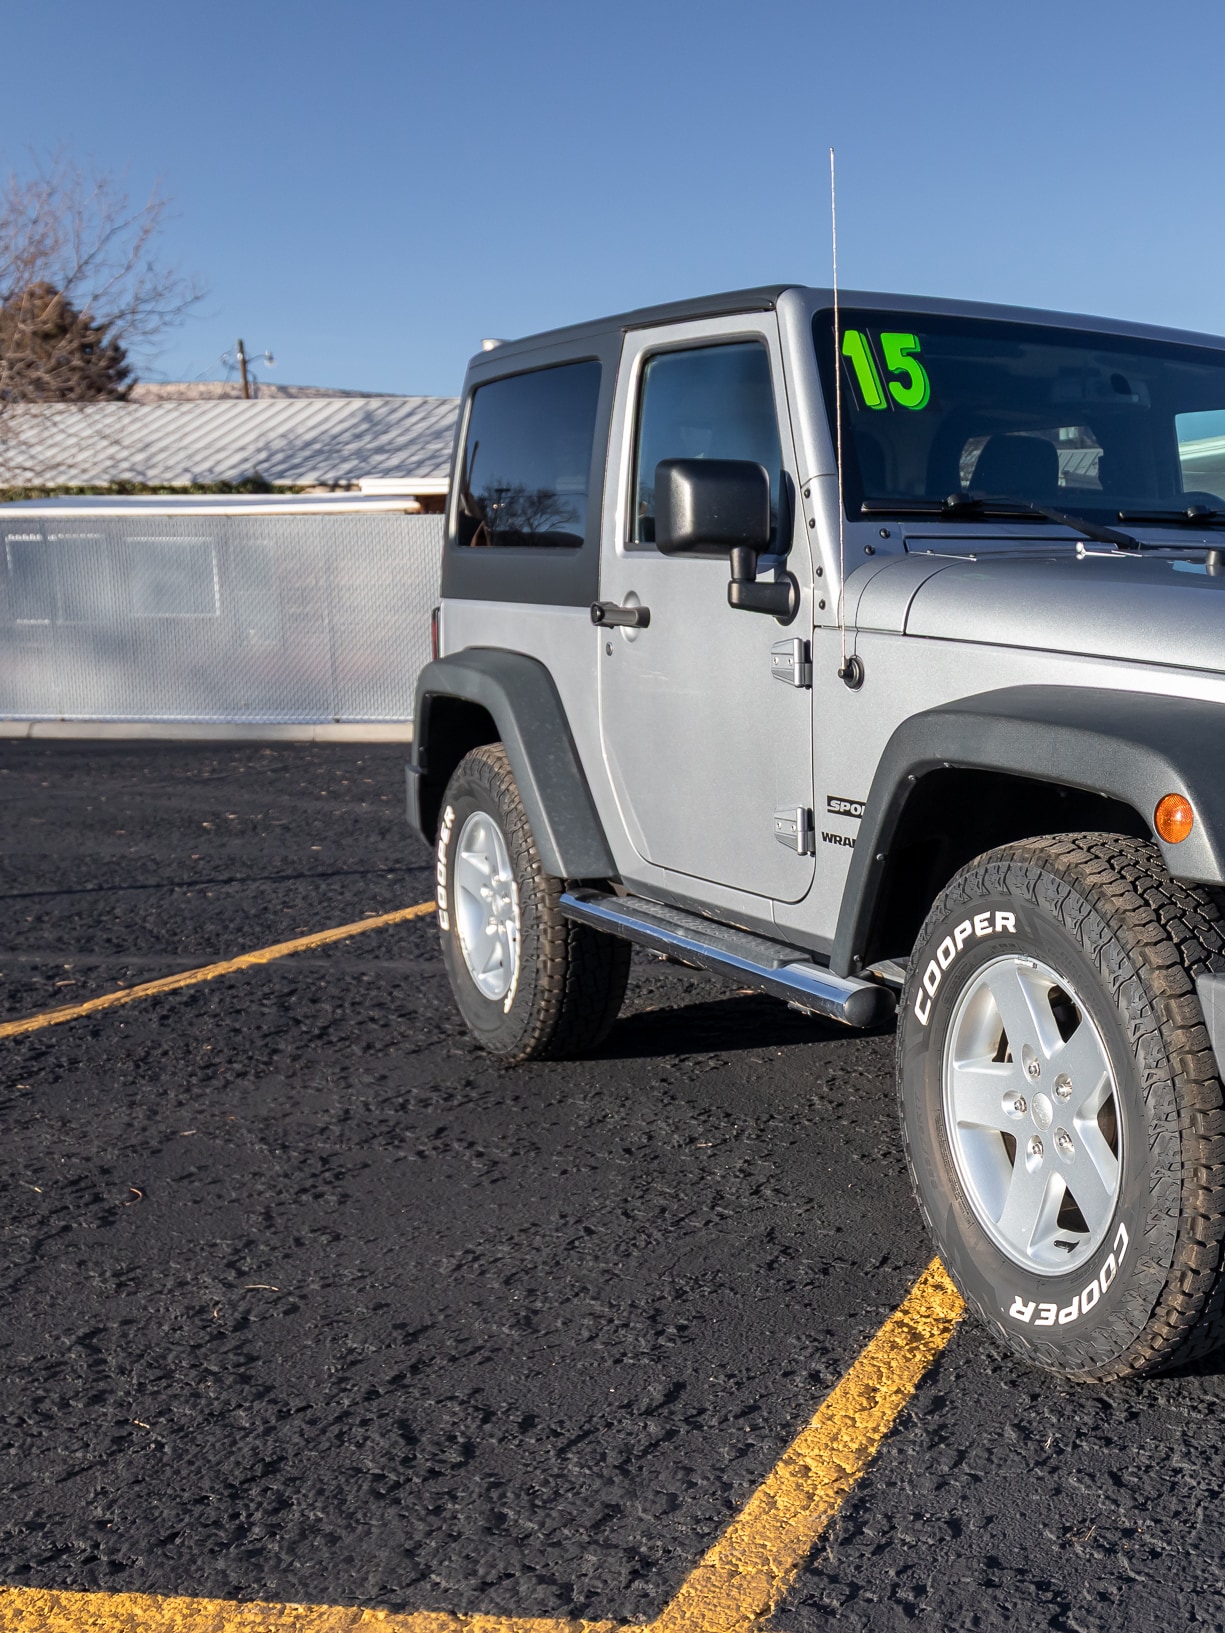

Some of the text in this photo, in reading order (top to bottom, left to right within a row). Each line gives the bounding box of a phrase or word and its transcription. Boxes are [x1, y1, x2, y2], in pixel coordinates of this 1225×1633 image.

[842, 329, 931, 411] 15
[436, 804, 456, 931] COOPER
[913, 910, 1017, 1026] COOPER
[1008, 1221, 1130, 1327] COOPER
